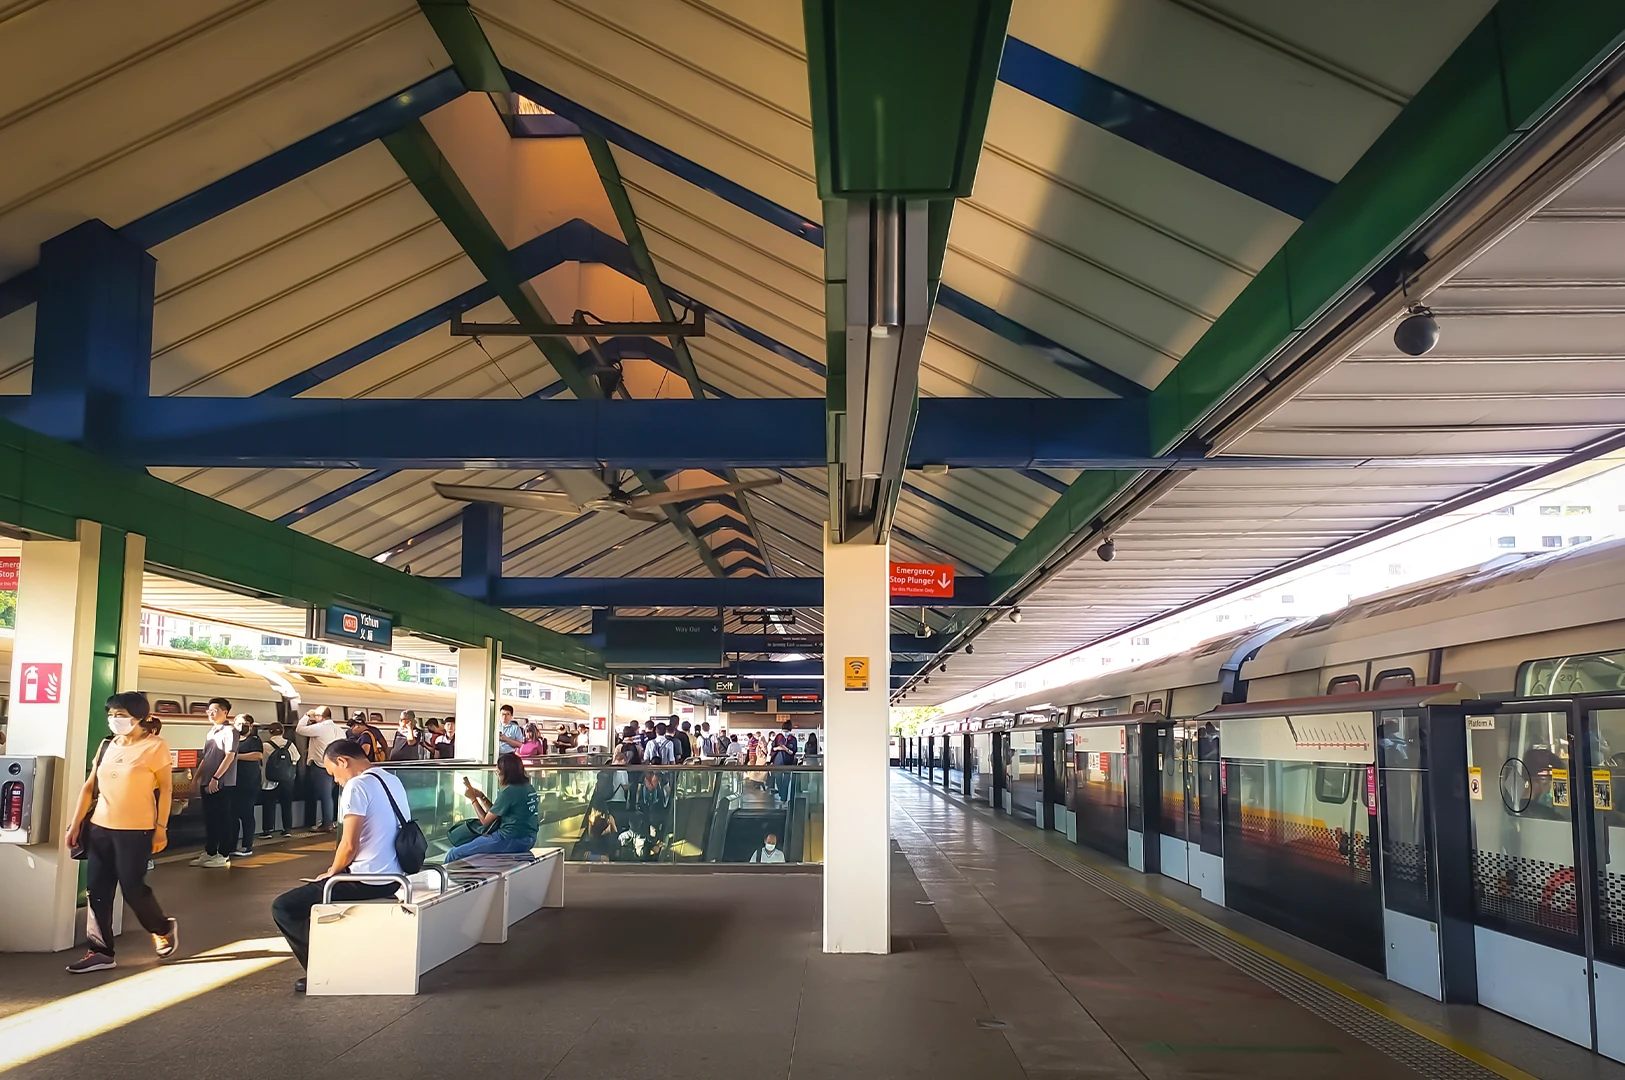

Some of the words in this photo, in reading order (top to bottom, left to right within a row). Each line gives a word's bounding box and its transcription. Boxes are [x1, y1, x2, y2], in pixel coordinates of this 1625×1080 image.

[896, 566, 935, 576] Emergency
[889, 576, 906, 584] Stop
[907, 577, 934, 586] Plunger
[360, 613, 379, 628] Yishun
[716, 681, 734, 690] Exit
[1468, 719, 1487, 727] Platform
